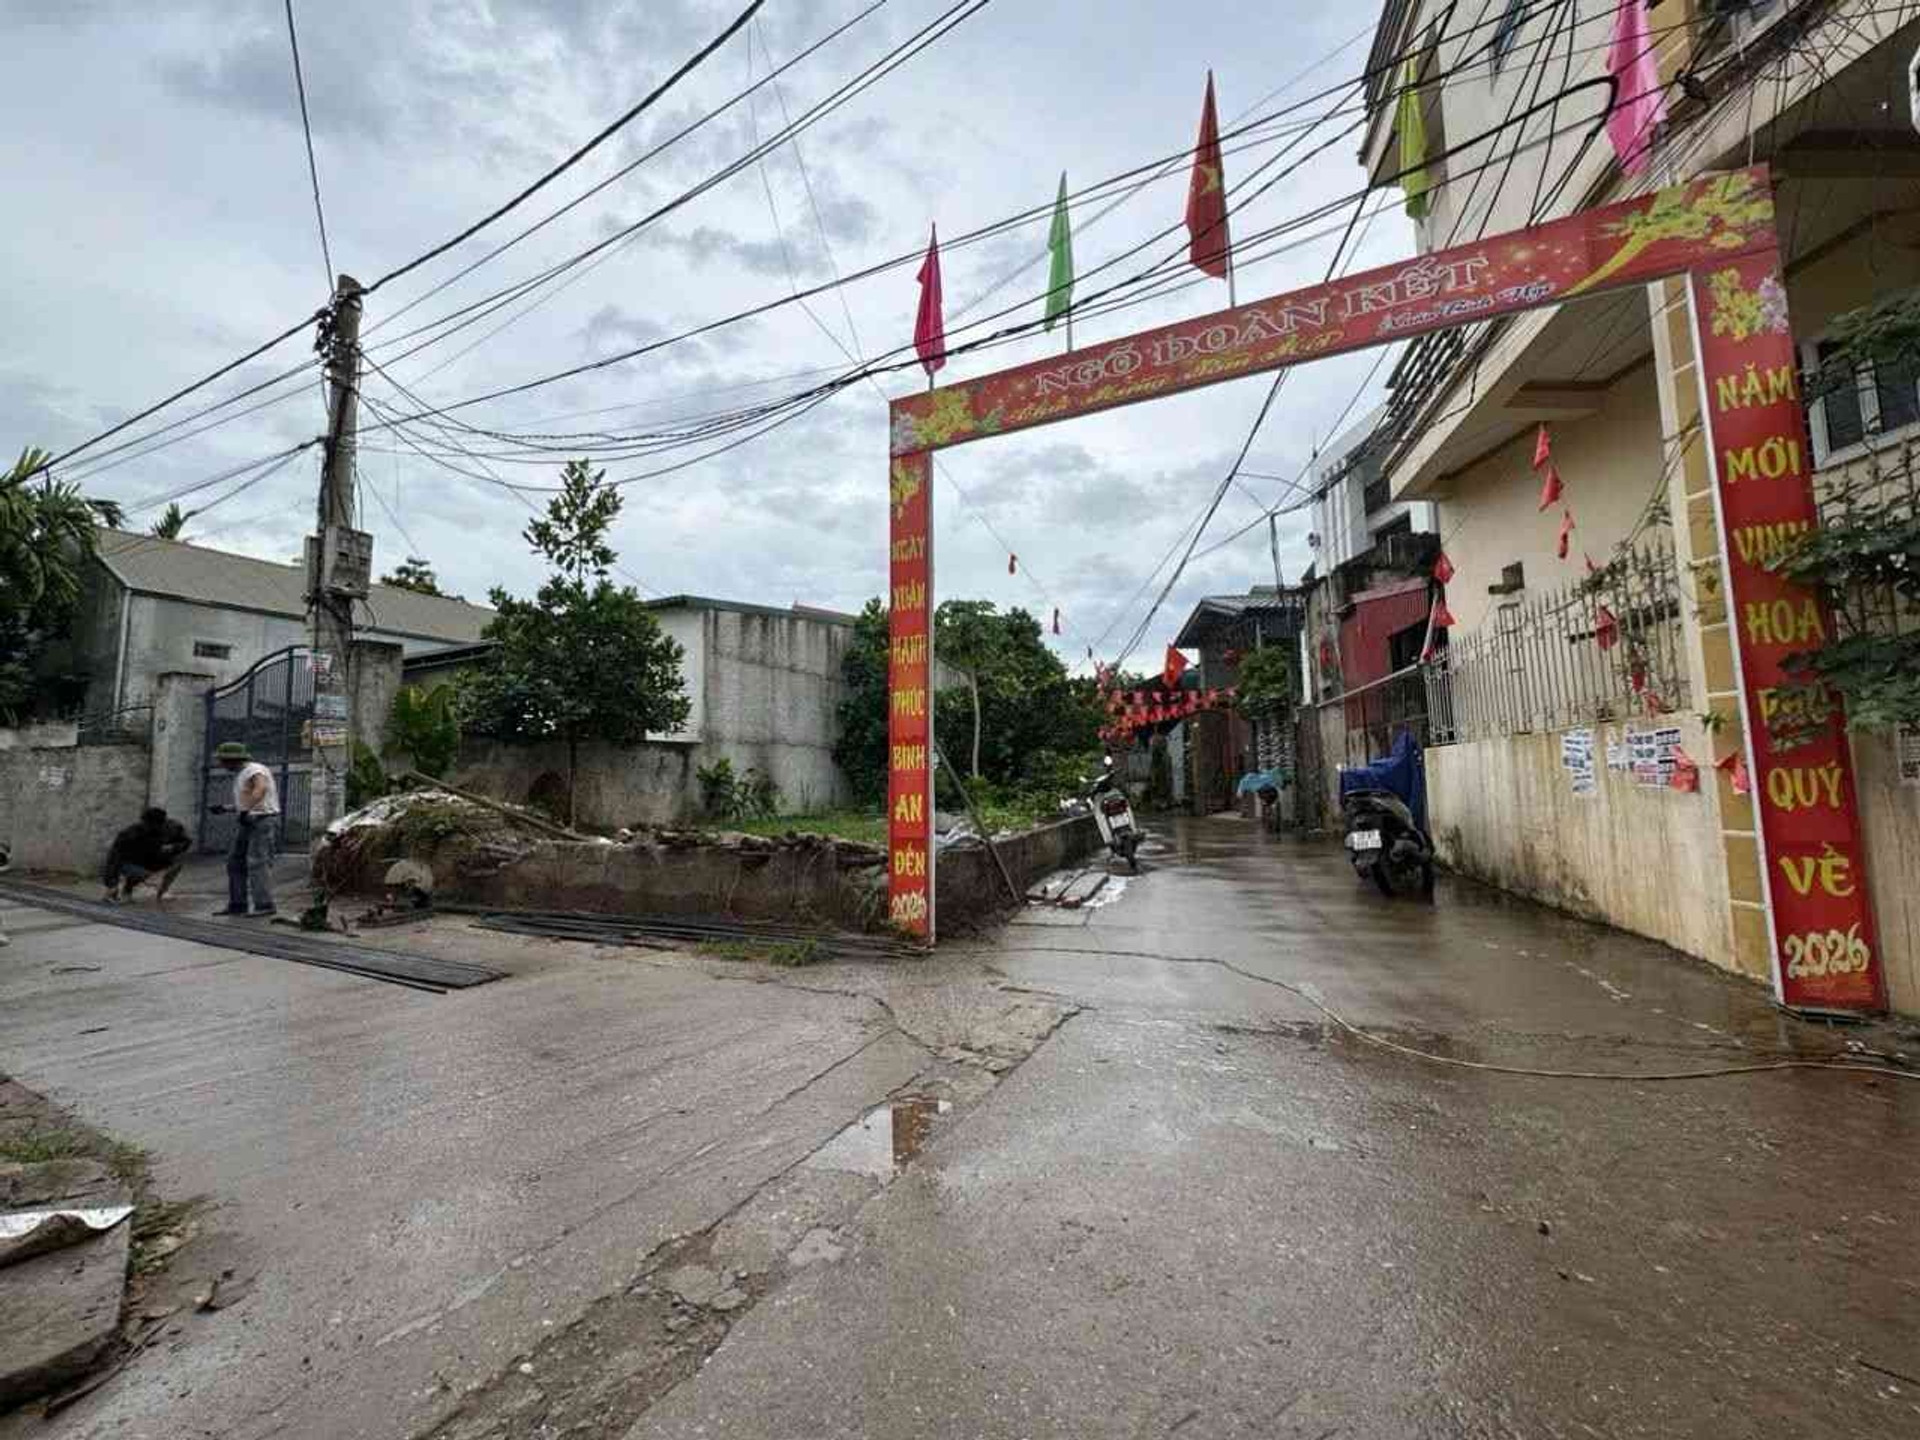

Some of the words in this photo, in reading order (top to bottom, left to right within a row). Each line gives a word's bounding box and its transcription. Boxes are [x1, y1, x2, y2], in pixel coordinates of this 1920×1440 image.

[1033, 344, 1142, 396] NGÕ
[1150, 297, 1331, 366] ĐOÀN
[1344, 256, 1489, 319] KẾT
[1716, 362, 1796, 412] NĂM
[1724, 437, 1800, 483] MỚI
[1746, 600, 1824, 646] HOA
[893, 741, 925, 770] BÌNH
[895, 794, 923, 823] AN
[1767, 760, 1844, 811] QUÝ
[894, 842, 925, 876] ĐẾN
[1778, 841, 1856, 897] VỀ
[891, 890, 926, 920] 2026
[1783, 923, 1871, 980] 2026
